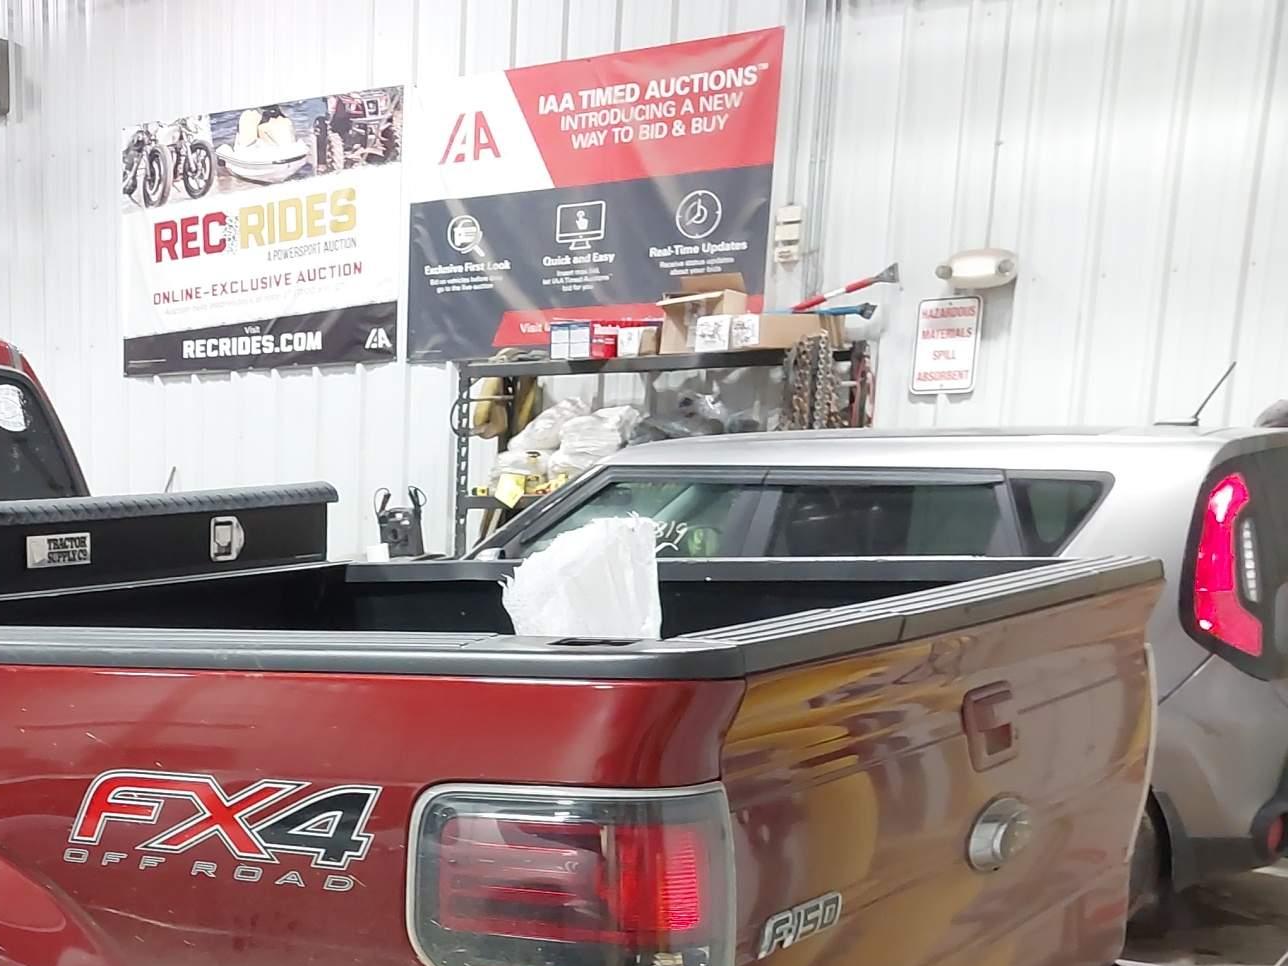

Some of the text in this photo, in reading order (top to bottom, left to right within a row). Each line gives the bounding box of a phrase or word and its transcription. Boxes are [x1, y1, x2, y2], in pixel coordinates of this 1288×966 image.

[538, 94, 575, 115] IAA
[579, 82, 640, 109] TIMED
[560, 91, 743, 131] INTRODUCING A NEW
[571, 113, 728, 150] WAY TO BID & BUY
[153, 187, 357, 263] REC RIDES
[323, 237, 358, 254] AUCTION
[543, 252, 615, 266] Quick and Easy
[649, 241, 748, 257] Real-Time Updates
[153, 272, 292, 305] ONLINE-EXCLUSIVE
[296, 261, 362, 283] AUCTION
[424, 259, 511, 275] Exclusive First Look
[520, 322, 540, 333] Visit
[182, 331, 322, 359] RECRIDES.COM
[68, 768, 383, 870] FX4
[63, 848, 355, 892] OFF ROAD
